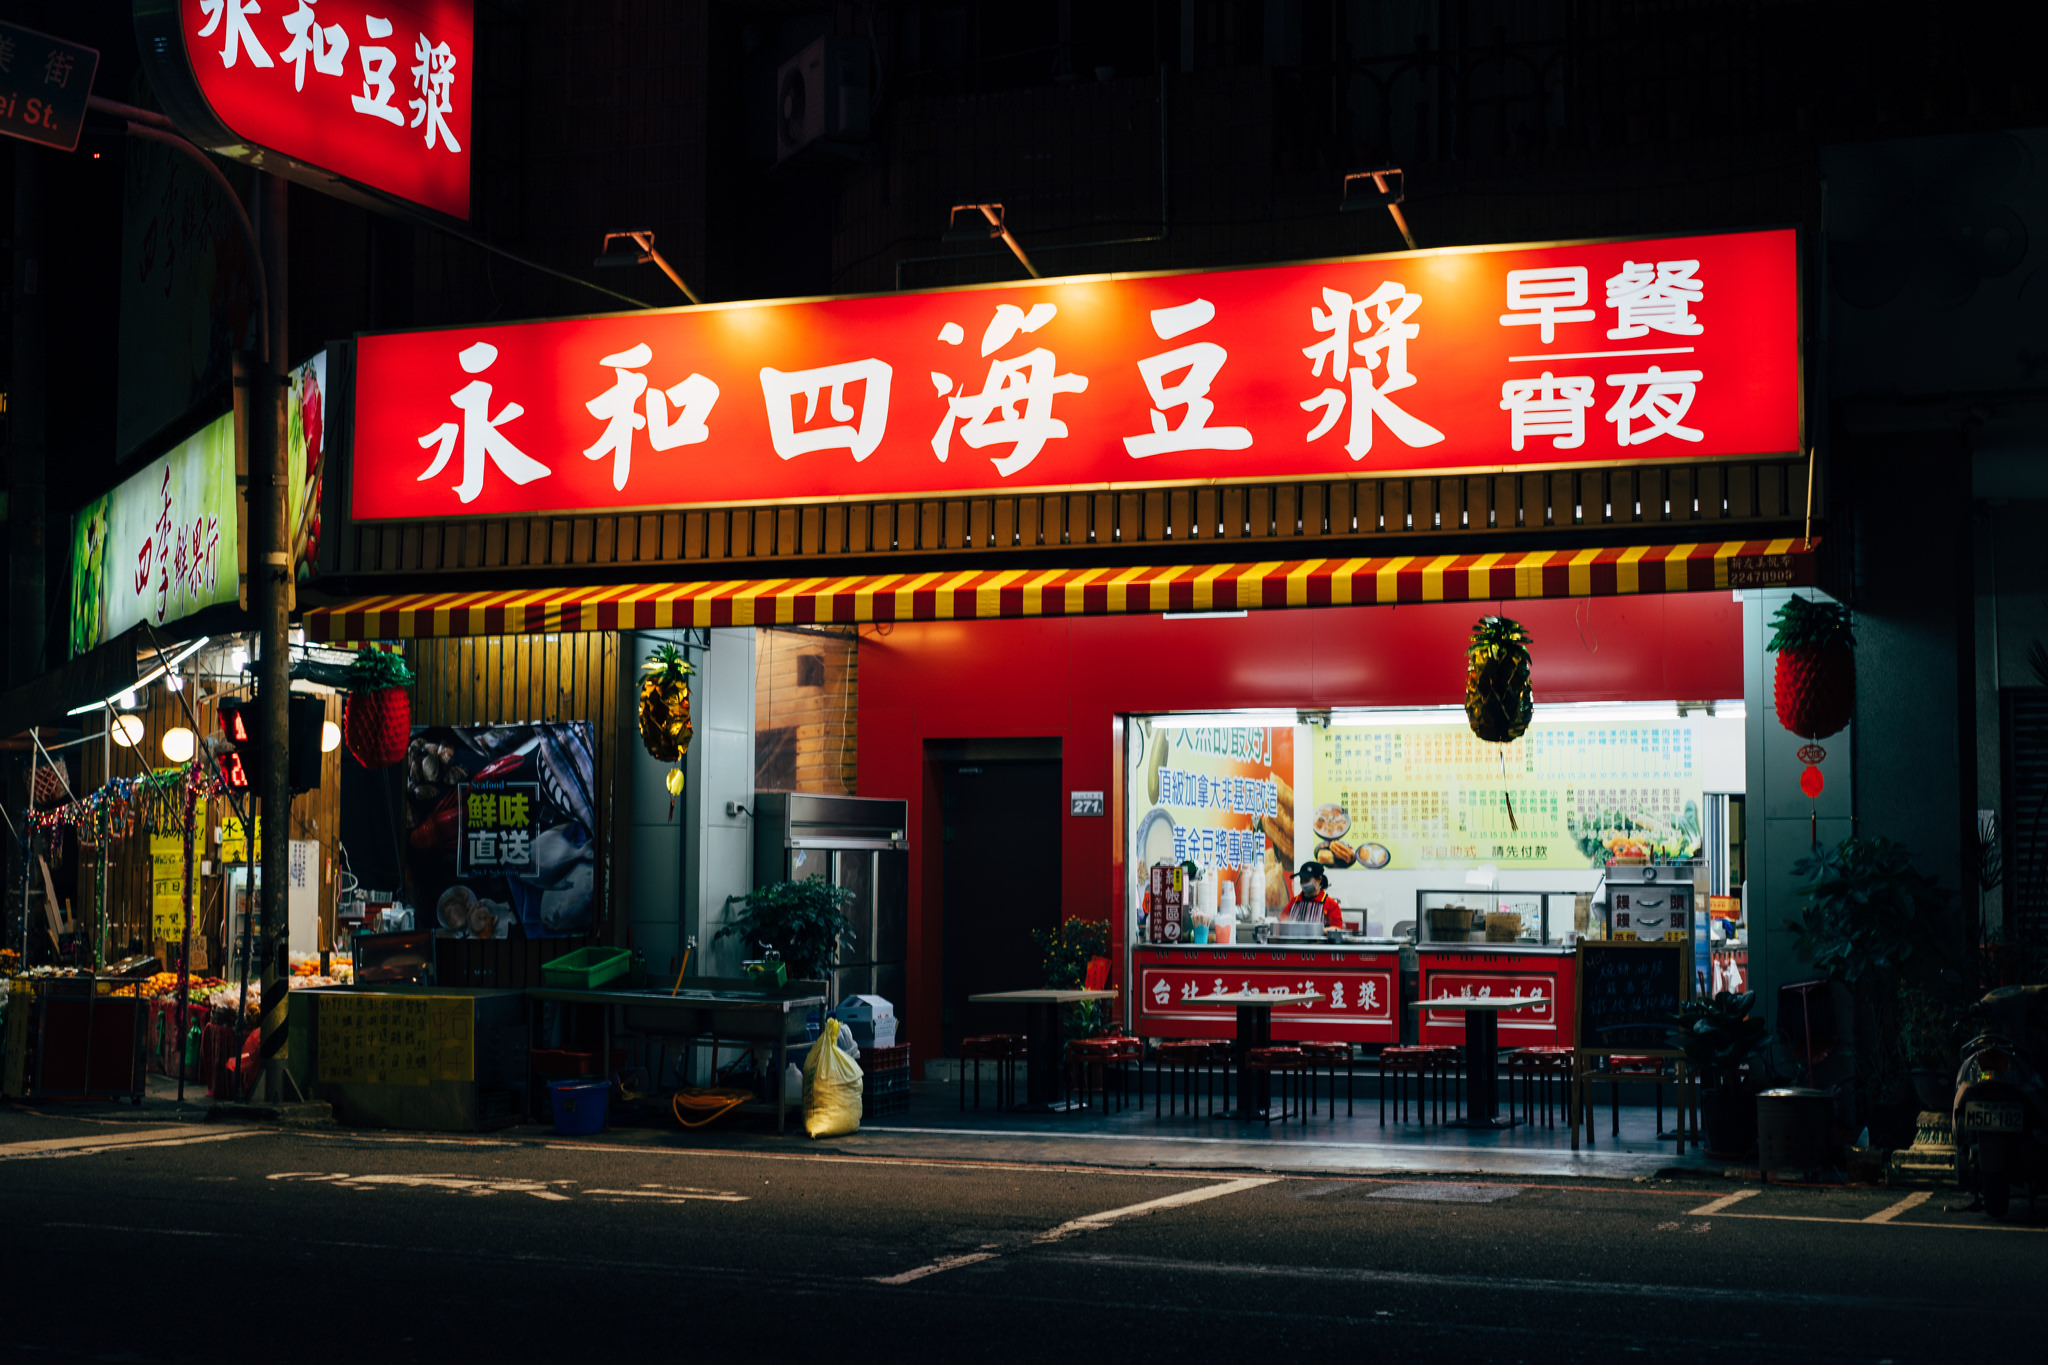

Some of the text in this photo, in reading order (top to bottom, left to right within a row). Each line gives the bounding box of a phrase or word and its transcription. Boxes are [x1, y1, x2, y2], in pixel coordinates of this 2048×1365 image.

[198, 0, 462, 153] 永和豆漿
[23, 97, 58, 130] St.
[1499, 258, 1705, 345] 早餐
[417, 280, 1447, 504] 永和四海豆漿
[1499, 365, 1705, 453] 宵夜
[134, 463, 219, 625] 四季鮮果行
[467, 792, 530, 829] 鮮味
[1158, 768, 1278, 816] 頂級加拿大非基因改造
[467, 830, 531, 866] 直送
[1173, 827, 1266, 871] 黃金豆漿專賣店
[1491, 845, 1547, 858] 請先付款
